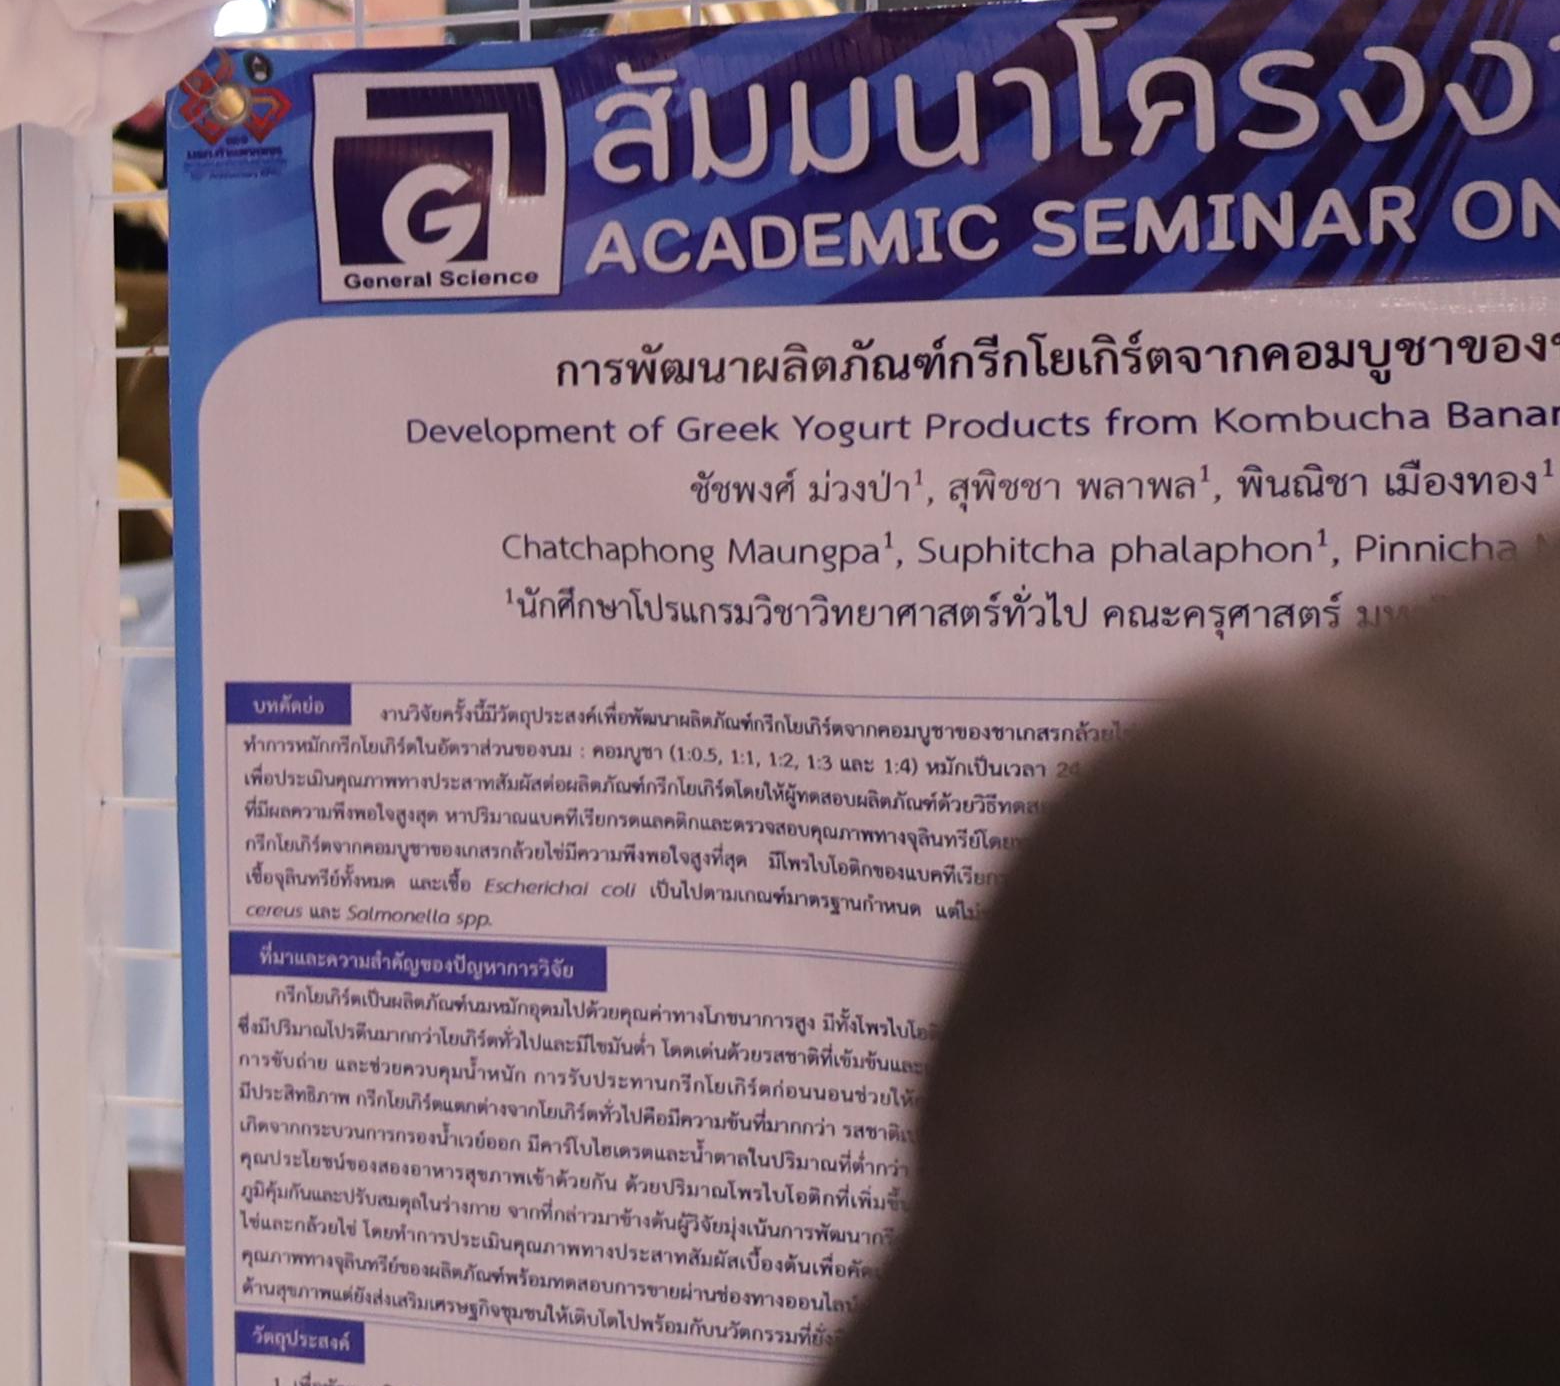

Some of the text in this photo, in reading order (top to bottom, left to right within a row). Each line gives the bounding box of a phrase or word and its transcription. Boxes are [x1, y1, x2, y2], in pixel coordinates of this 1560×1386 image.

[592, 16, 1560, 183] สัมมนาโครงง
[585, 204, 1000, 277] ACADEMIC
[1032, 183, 1419, 258] SEMINAR
[343, 268, 540, 291] General Science
[556, 330, 1560, 388] การพัฒนาผลิตภัณฑ์กรีกโยเกิร์ตจากคอมบูชาของ
[406, 416, 616, 450] Development
[628, 415, 665, 445] of
[676, 414, 780, 444] Greek
[791, 414, 912, 448] Yogurt
[925, 409, 1091, 440] Products
[1105, 407, 1198, 437] from
[1215, 401, 1431, 435] Kombucha
[689, 467, 797, 505] ชัชพงศ์
[948, 468, 1061, 512] สุพิชชา
[1236, 462, 1369, 499] พินณิชา
[502, 532, 717, 572] Chatchaphong
[917, 535, 1096, 572] Suphitcha
[1355, 532, 1519, 565] Pinnicha
[1103, 591, 1342, 641] คณะครุศาสตร์
[253, 695, 325, 715] บทคัดย่อ
[592, 744, 662, 767] คอมบูชา
[807, 753, 832, 772] 1:3
[840, 758, 875, 774] และ
[926, 754, 1047, 780] หมักเป็นเวลา
[244, 763, 1048, 815] เพื่อประเมินคุณภาพทางประสาทสัมผัสต่อผลิตภัณฑ์กรีกโยเกิร์ตโดยให้ผู้ทดสอบผลิตภัณฑ์ด้วยวิธีทดส
[768, 850, 1008, 887] มีโพรไบโอติกของแบคทีเรียก
[601, 882, 636, 898] coli
[309, 905, 341, 921] และ
[345, 904, 450, 926] Salmonella
[456, 912, 493, 931] spp.
[259, 941, 575, 980] ที่มาและความสำคัญของปัญหาการวิจัย
[238, 1049, 328, 1072] การขับถ่าย
[239, 1081, 350, 1106] มีประสิทธิภาพ
[507, 1198, 898, 1247] จากที่กล่าวมาข้างต้นผู้วิจัยมุ่งเน้นการพัฒนากรี
[252, 1326, 351, 1353] วัตถุประสงค์
